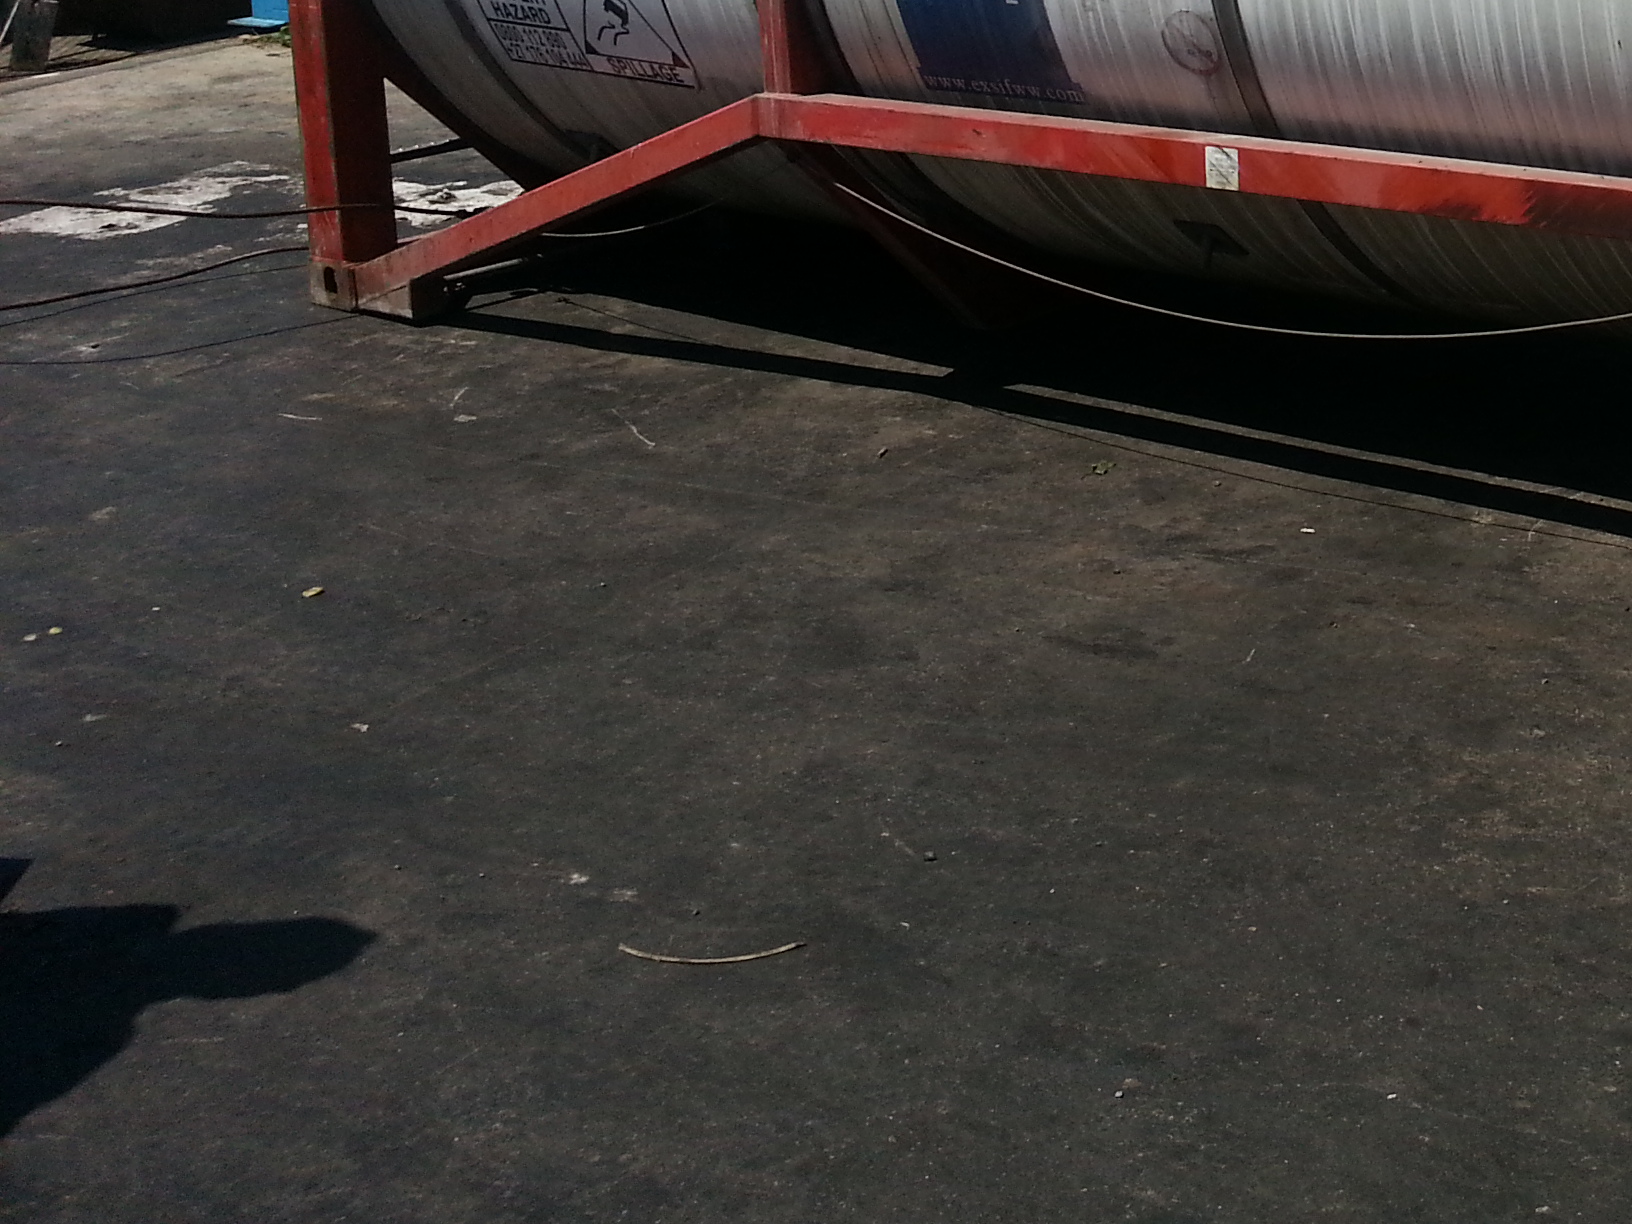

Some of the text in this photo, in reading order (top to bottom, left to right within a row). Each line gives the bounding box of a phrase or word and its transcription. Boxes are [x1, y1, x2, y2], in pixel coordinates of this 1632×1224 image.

[491, 1, 551, 25] HAZARD
[606, 57, 685, 83] SPILLAGE
[923, 74, 1086, 102] www.exsifww.com
